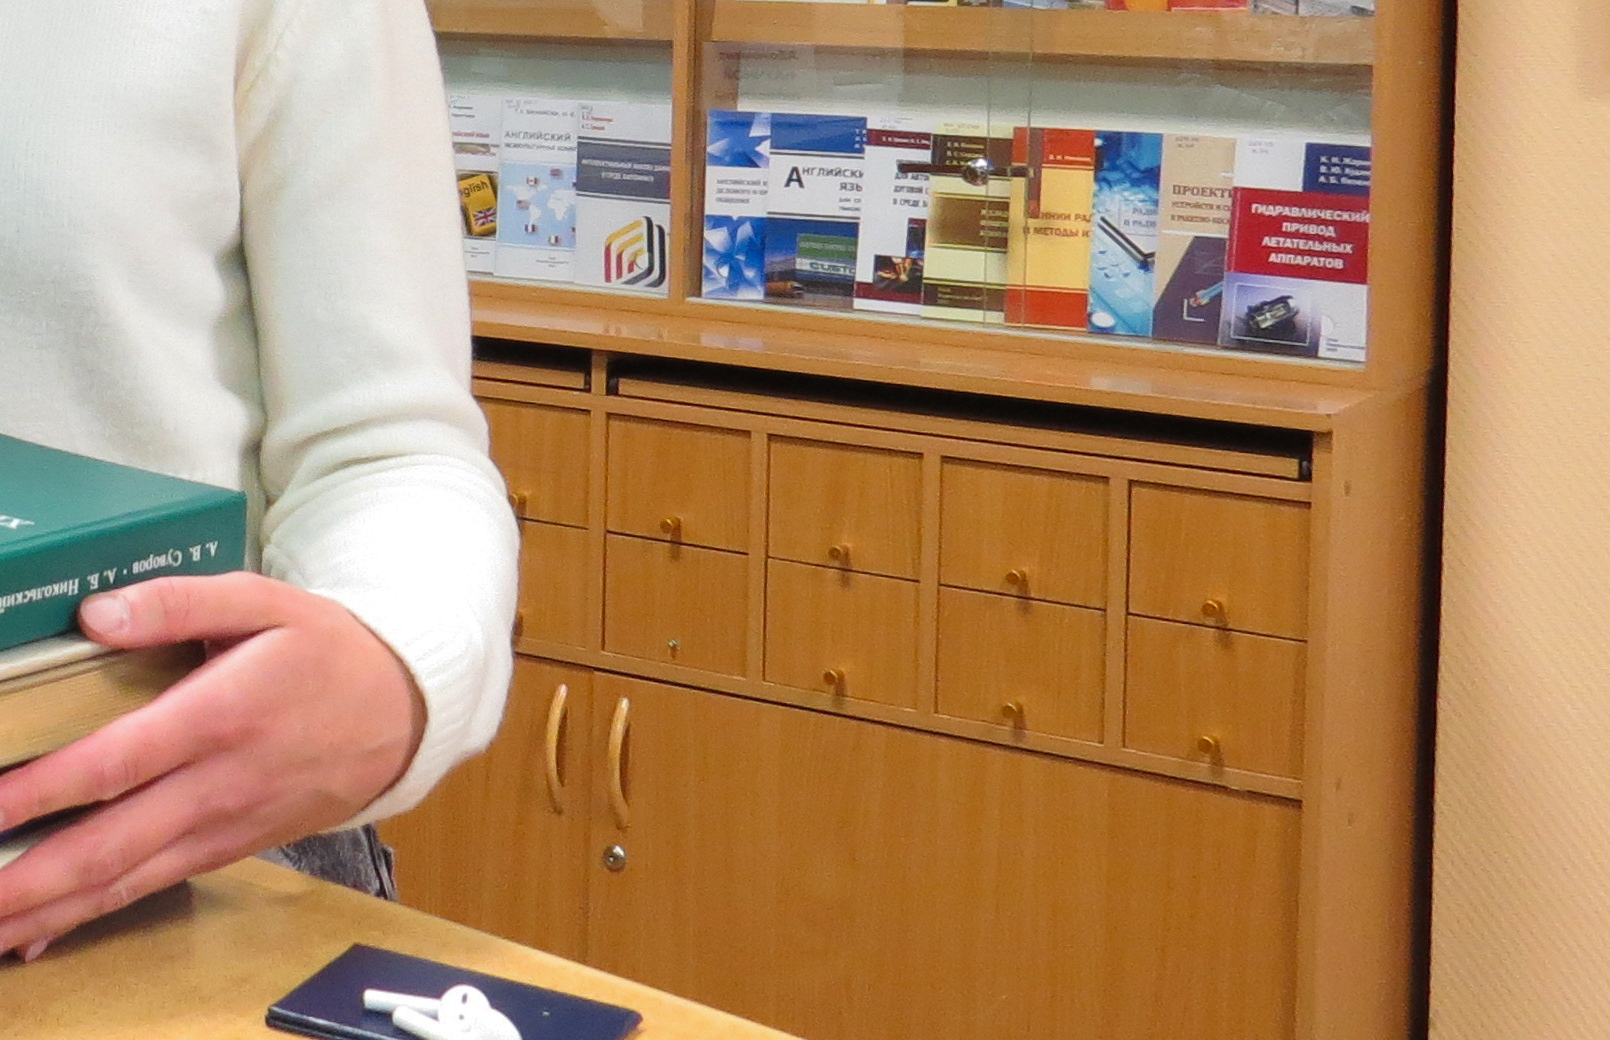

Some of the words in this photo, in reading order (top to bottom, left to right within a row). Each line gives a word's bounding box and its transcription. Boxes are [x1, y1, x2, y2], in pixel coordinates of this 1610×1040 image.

[504, 130, 572, 142] АНГЛИЙСКИЙ
[1251, 203, 1370, 223] ГИДРАВЛИЧЕСКИЙ
[1033, 227, 1080, 238] МЕТОДЫ
[1282, 222, 1336, 237] ПРИВОД
[1262, 236, 1353, 254] ЛЕТАТЕЛЬНЫХ
[1268, 252, 1344, 270] АППАРАТОВ
[189, 545, 201, 561] В.
[205, 541, 218, 558] А.
[131, 548, 183, 574] Суворов
[86, 573, 99, 589] Б.
[103, 567, 117, 585] А.
